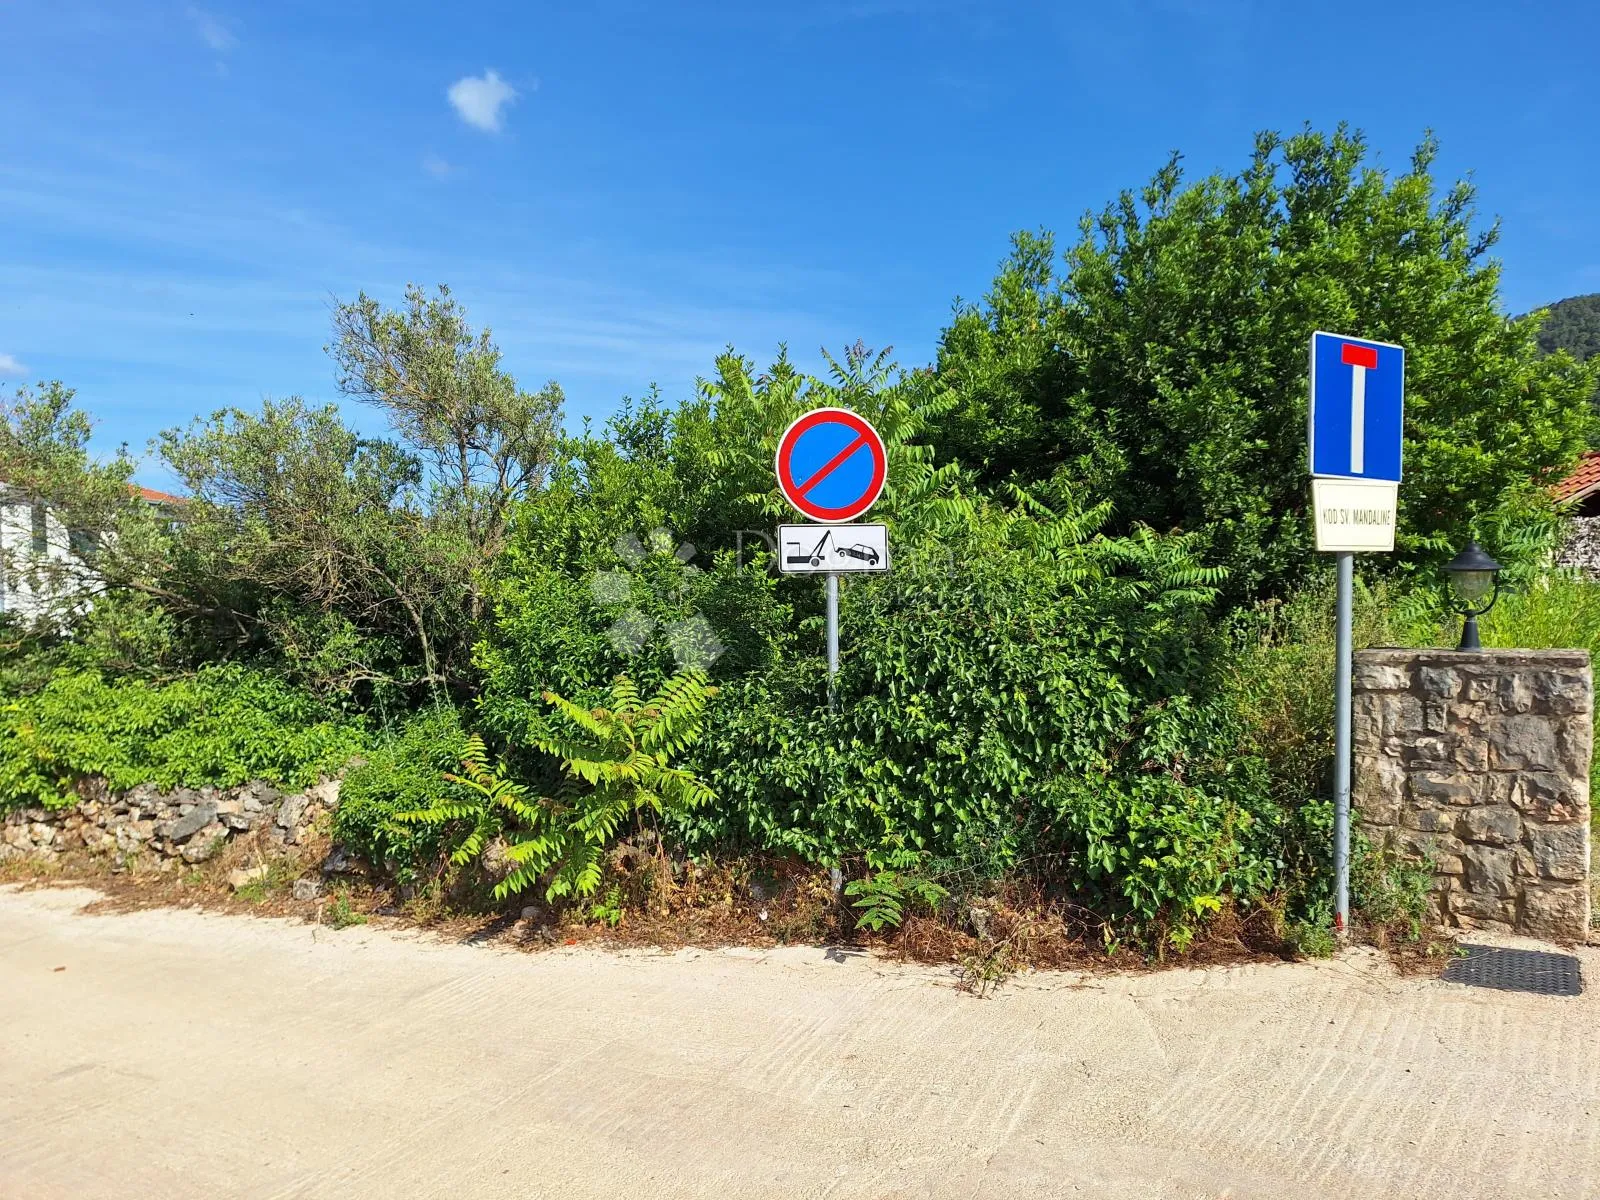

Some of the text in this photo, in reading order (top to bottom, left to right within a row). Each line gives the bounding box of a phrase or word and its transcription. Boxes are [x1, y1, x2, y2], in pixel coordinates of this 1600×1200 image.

[1323, 508, 1391, 526] KOD SV. MANDALINE
